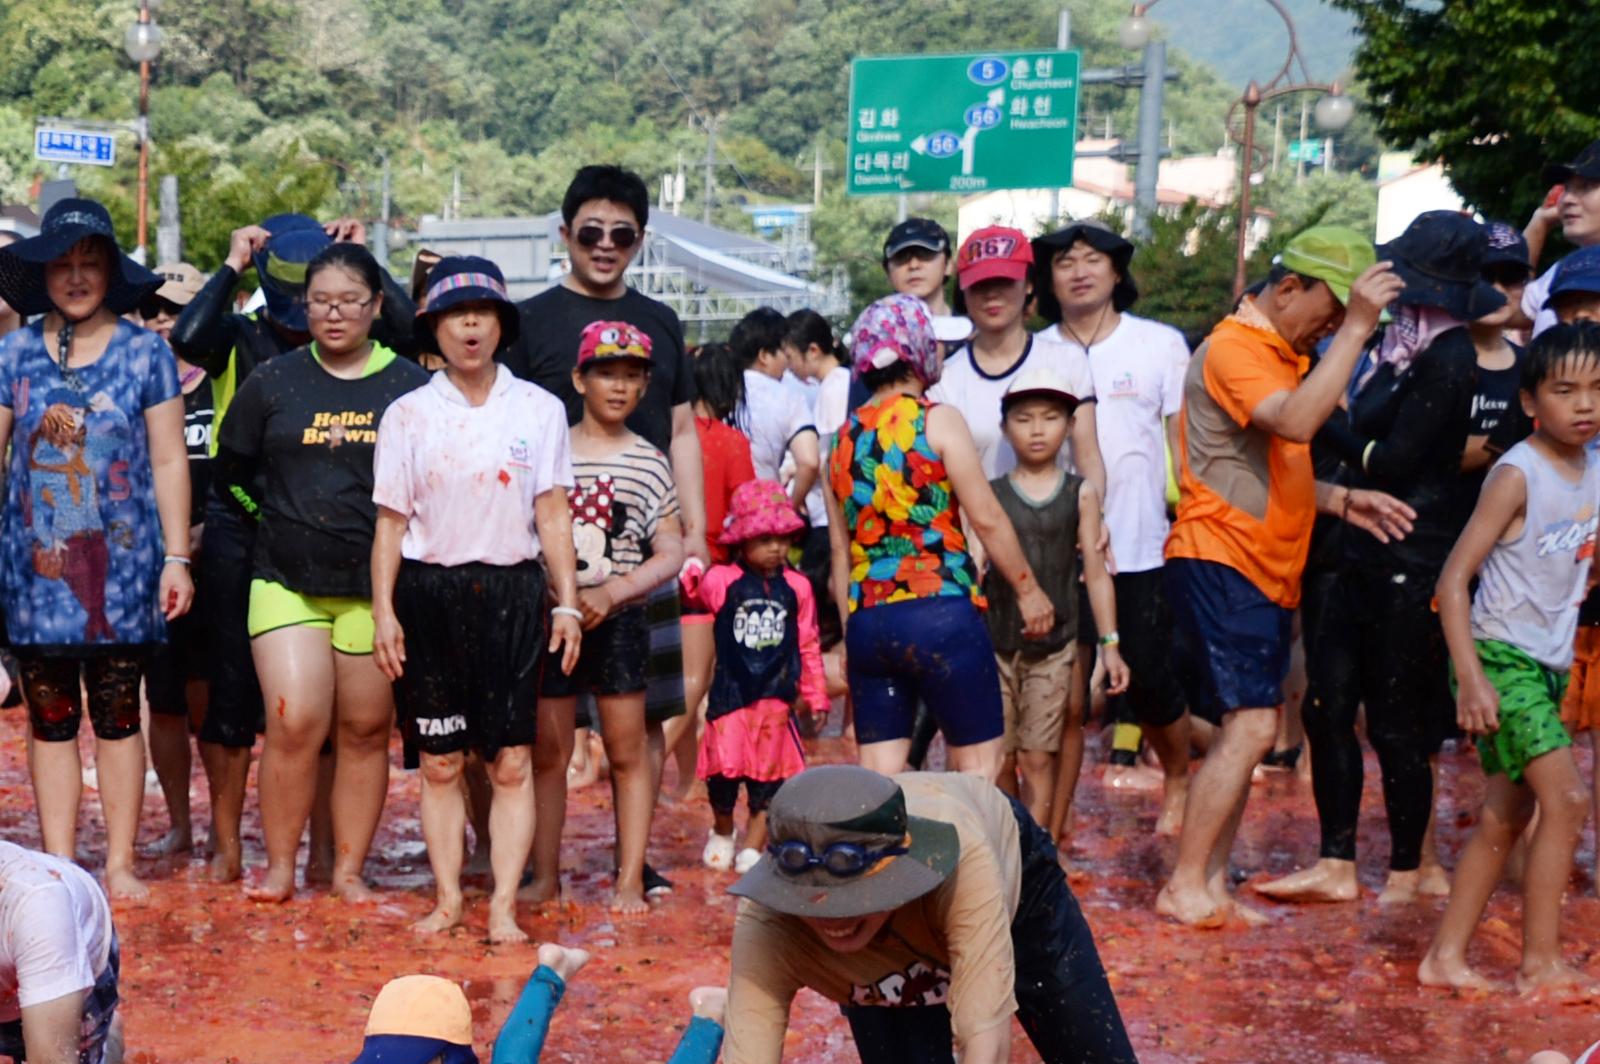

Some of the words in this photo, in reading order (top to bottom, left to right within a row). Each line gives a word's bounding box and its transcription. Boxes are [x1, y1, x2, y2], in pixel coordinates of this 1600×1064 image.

[982, 63, 995, 79] 5
[972, 109, 995, 126] 56
[930, 137, 955, 154] 56
[854, 152, 910, 171] 다목리
[950, 176, 988, 190] 200m
[313, 411, 375, 427] Hello!
